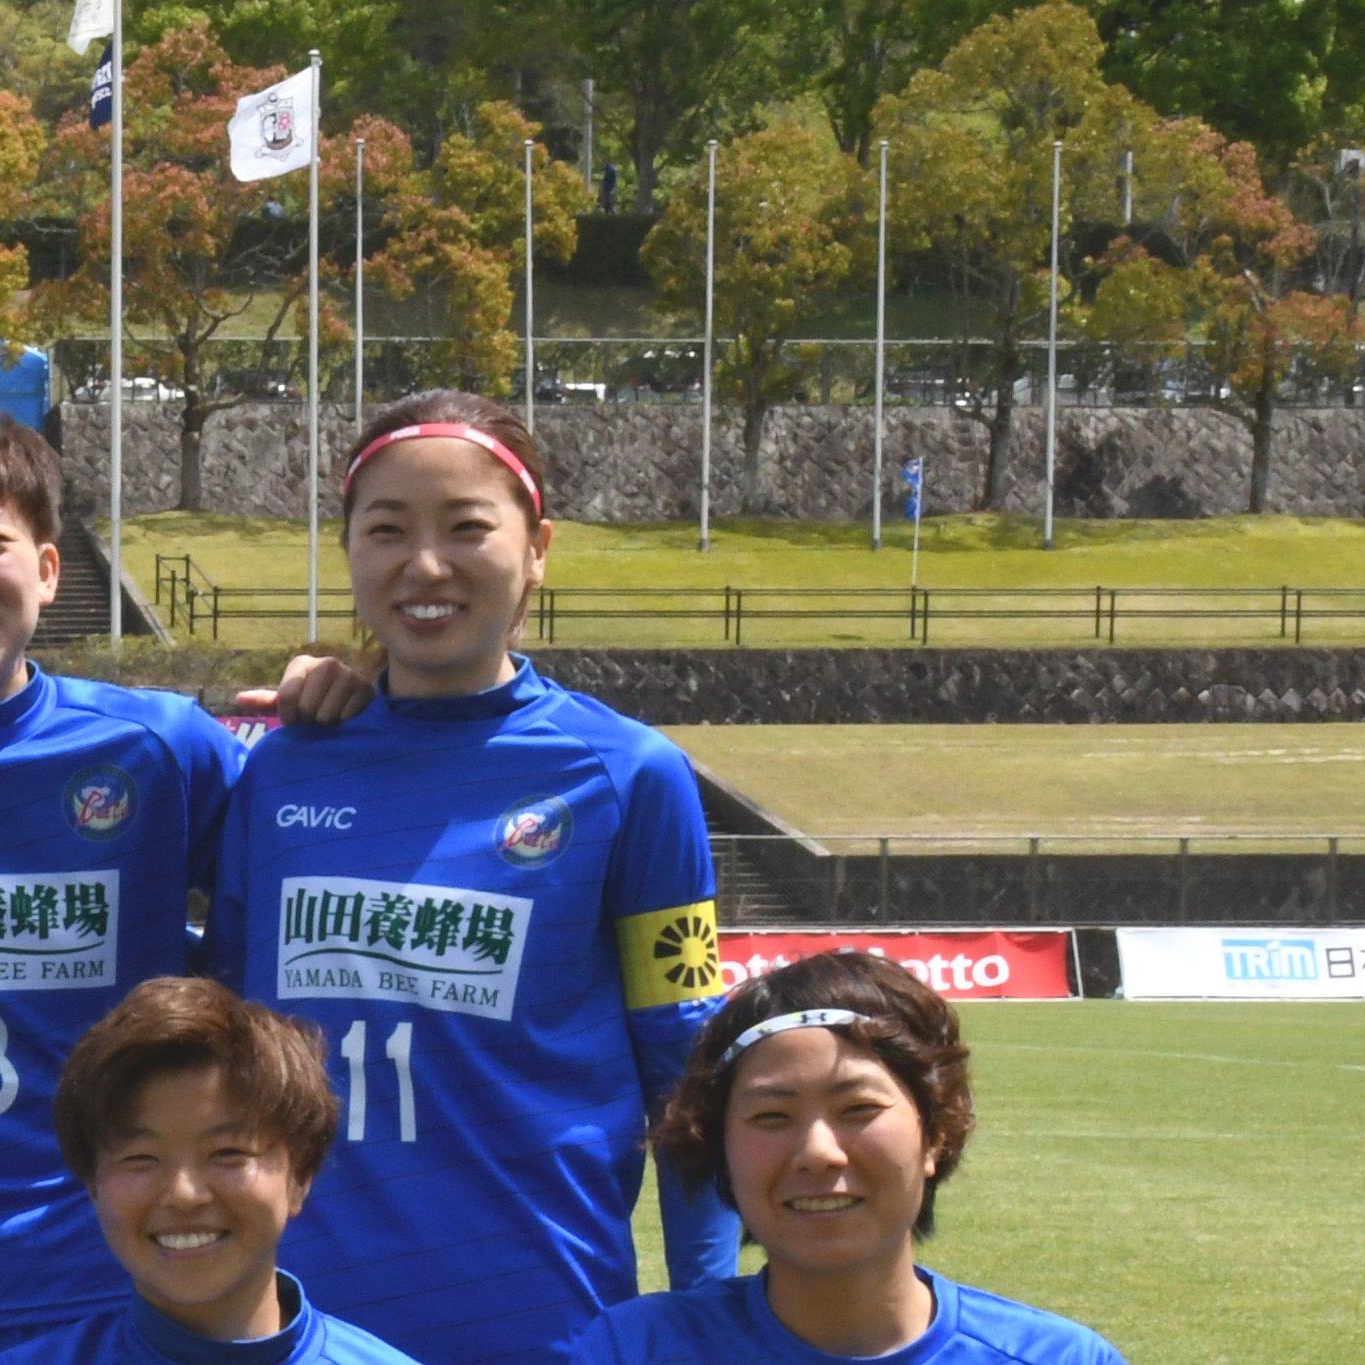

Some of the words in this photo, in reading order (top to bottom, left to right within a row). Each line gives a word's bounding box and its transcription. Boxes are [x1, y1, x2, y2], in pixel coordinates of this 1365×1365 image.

[284, 888, 515, 966] 山田養蜂場
[41, 959, 105, 979] FARM
[284, 968, 364, 989] YAMADA
[378, 972, 419, 995] BEE
[430, 980, 501, 1008] FARM
[340, 1020, 417, 1142] 11
